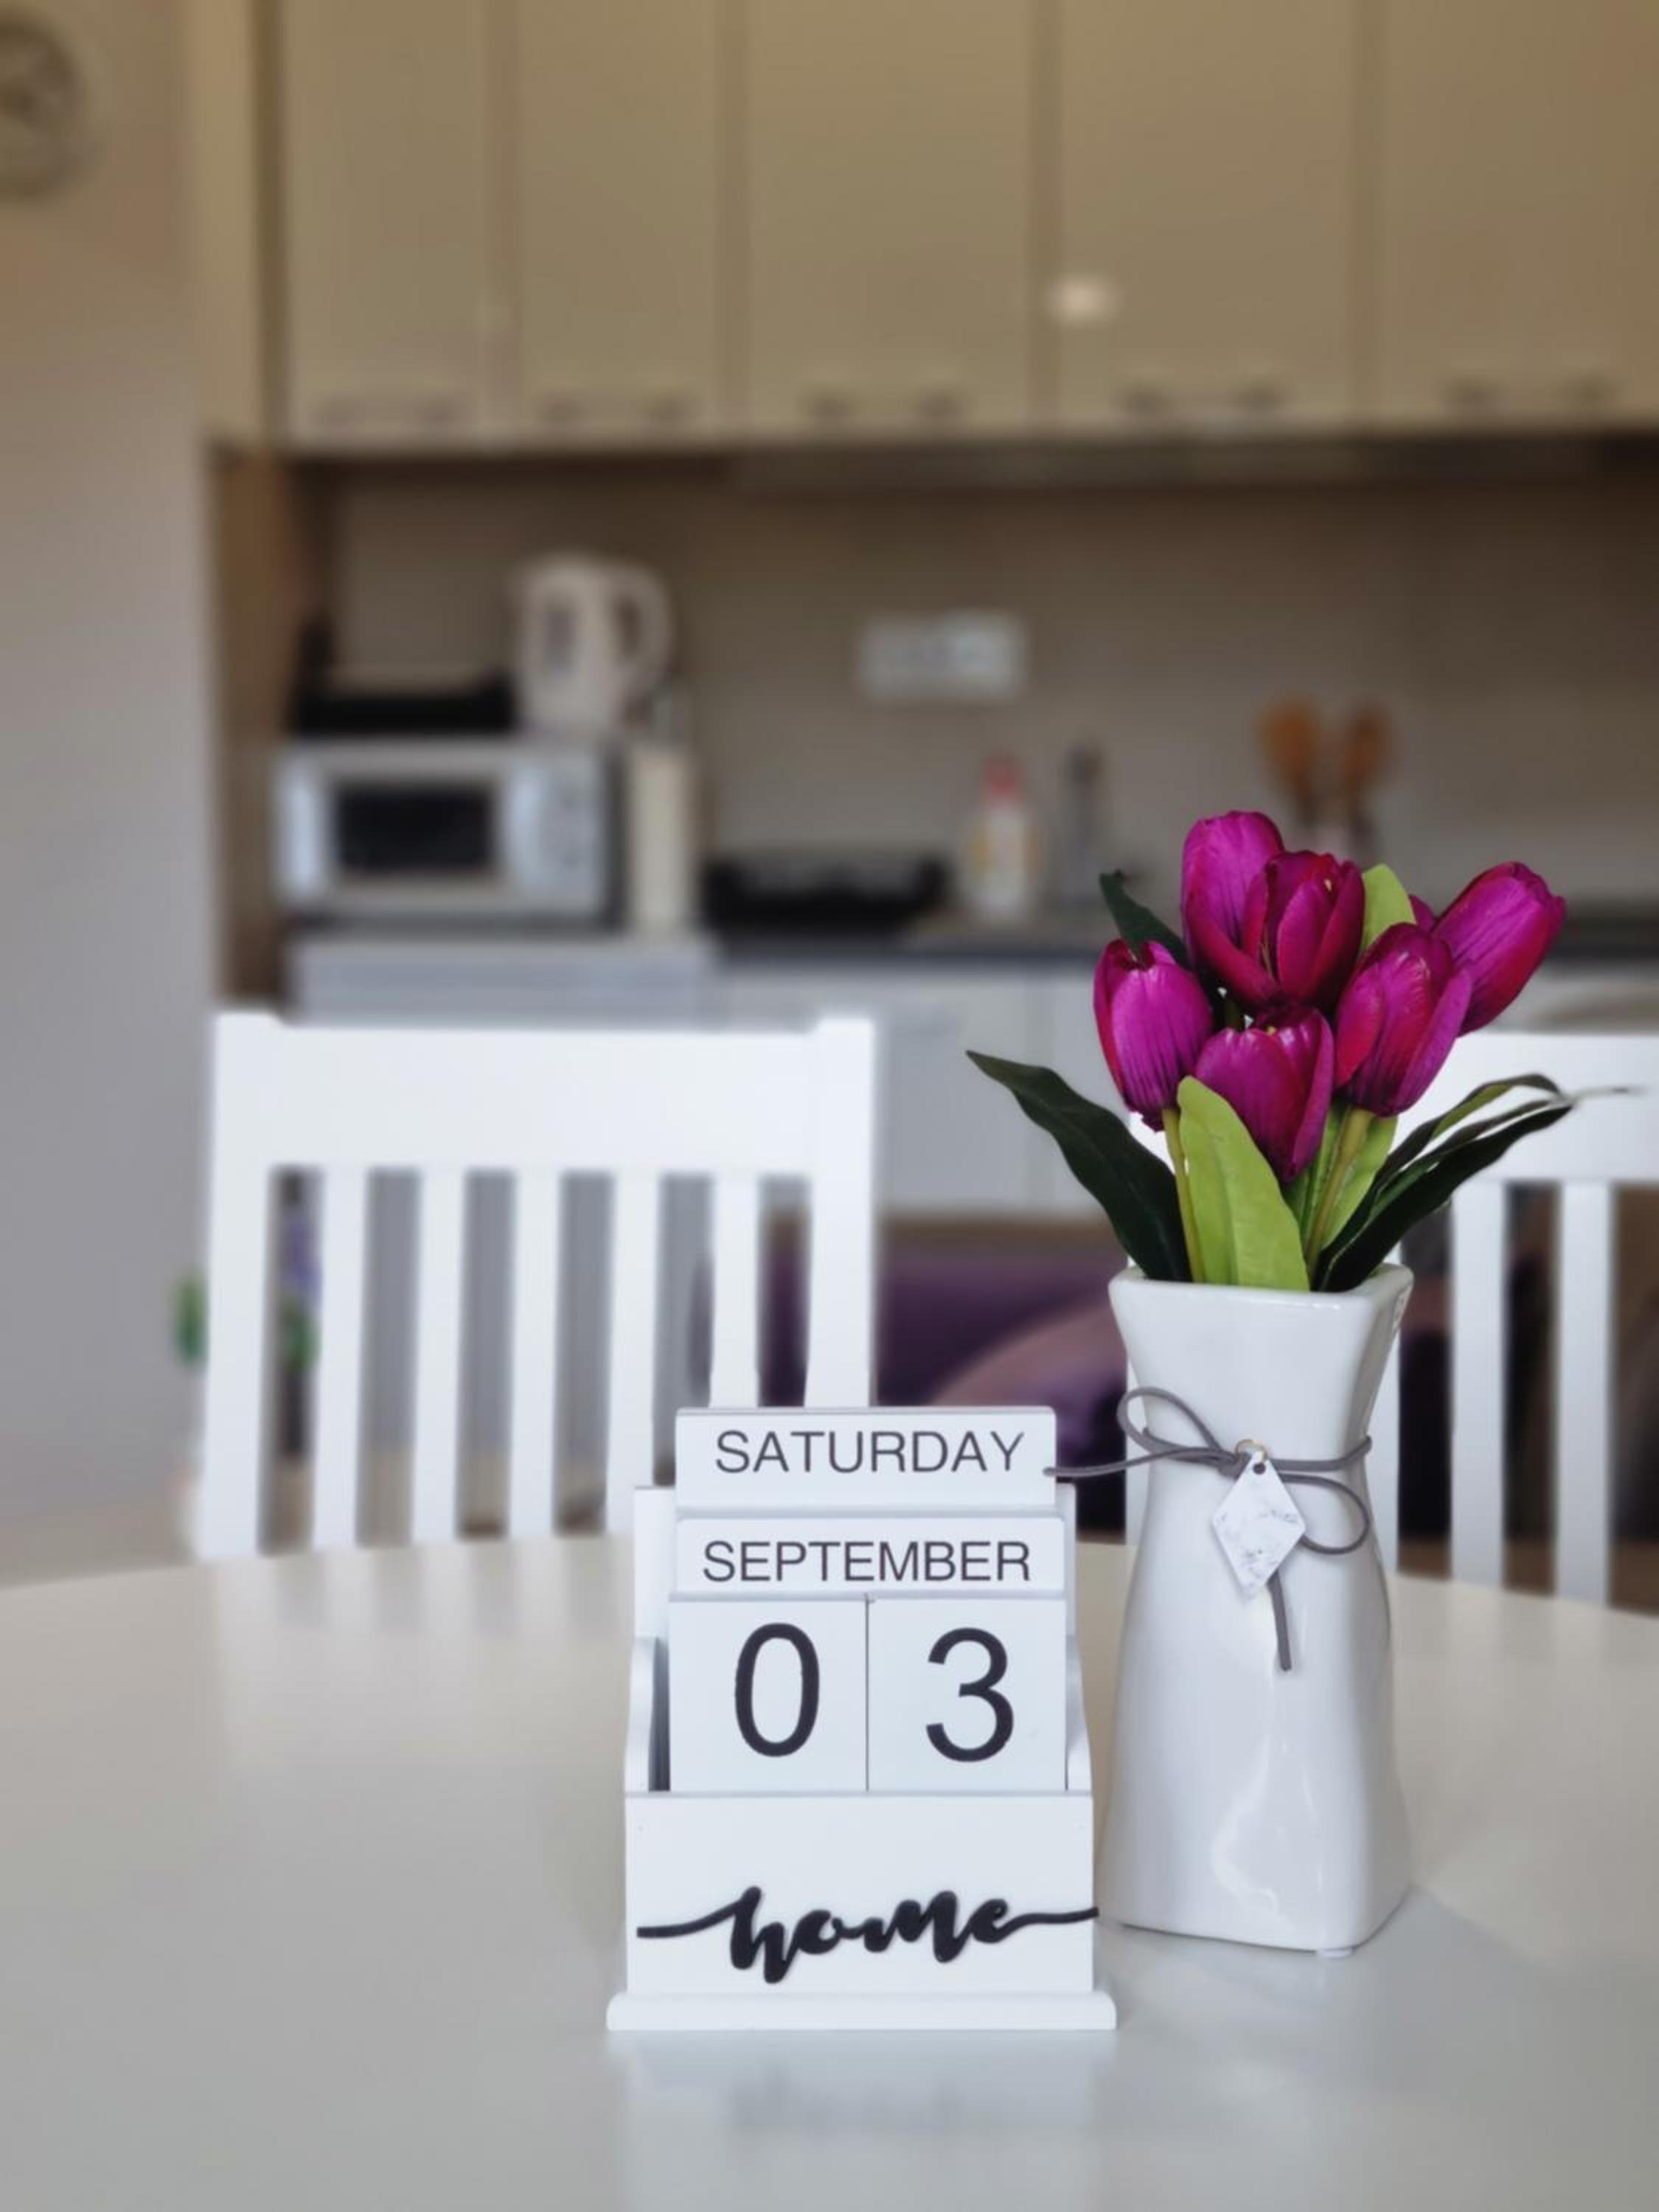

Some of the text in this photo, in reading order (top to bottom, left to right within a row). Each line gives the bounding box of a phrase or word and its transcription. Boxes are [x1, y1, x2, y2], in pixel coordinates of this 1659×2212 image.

[715, 1430, 1025, 1473] SATURDAY
[703, 1540, 1031, 1582] SEPTEMBER
[636, 1886, 1099, 1984] home
